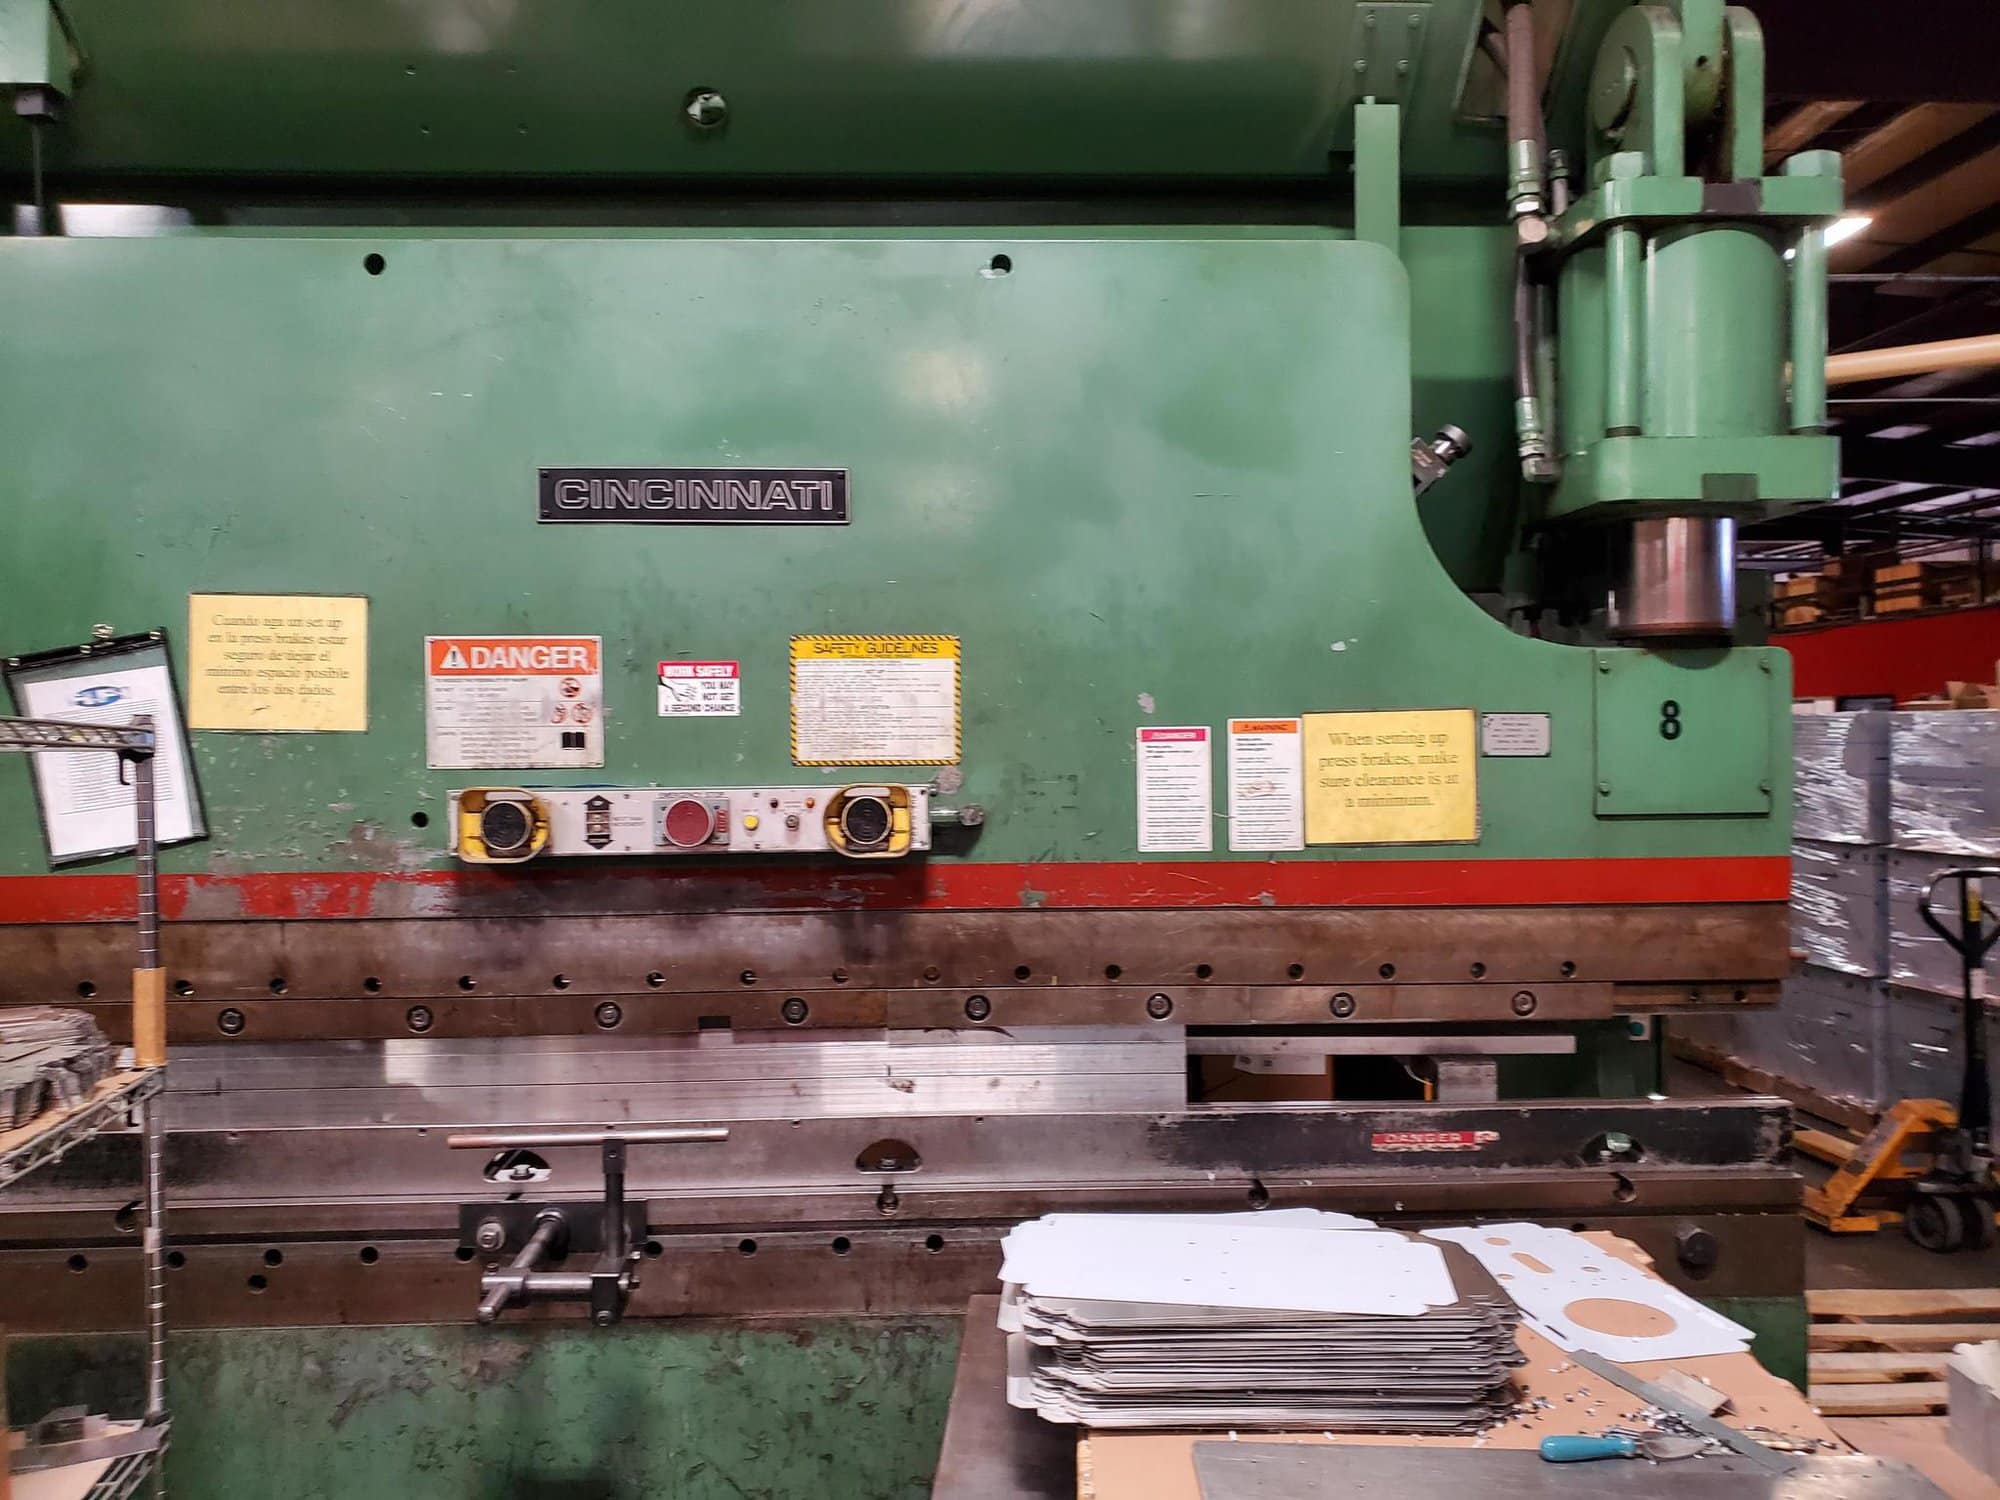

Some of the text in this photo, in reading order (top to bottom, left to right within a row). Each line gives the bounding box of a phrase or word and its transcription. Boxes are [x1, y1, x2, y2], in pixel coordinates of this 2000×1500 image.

[554, 478, 833, 511] CINCINNATI
[813, 642, 938, 654] SAFETY GUIDELINES
[471, 645, 588, 670] DANGER
[1659, 699, 1683, 741] 8
[1328, 731, 1449, 748] When setting up
[1318, 757, 1358, 771] press
[1418, 751, 1459, 765] make
[1319, 776, 1352, 788] sure
[1354, 773, 1425, 787] clearance
[1428, 771, 1442, 785] is
[1345, 798, 1355, 808] a
[1384, 1133, 1462, 1144] DANGER
